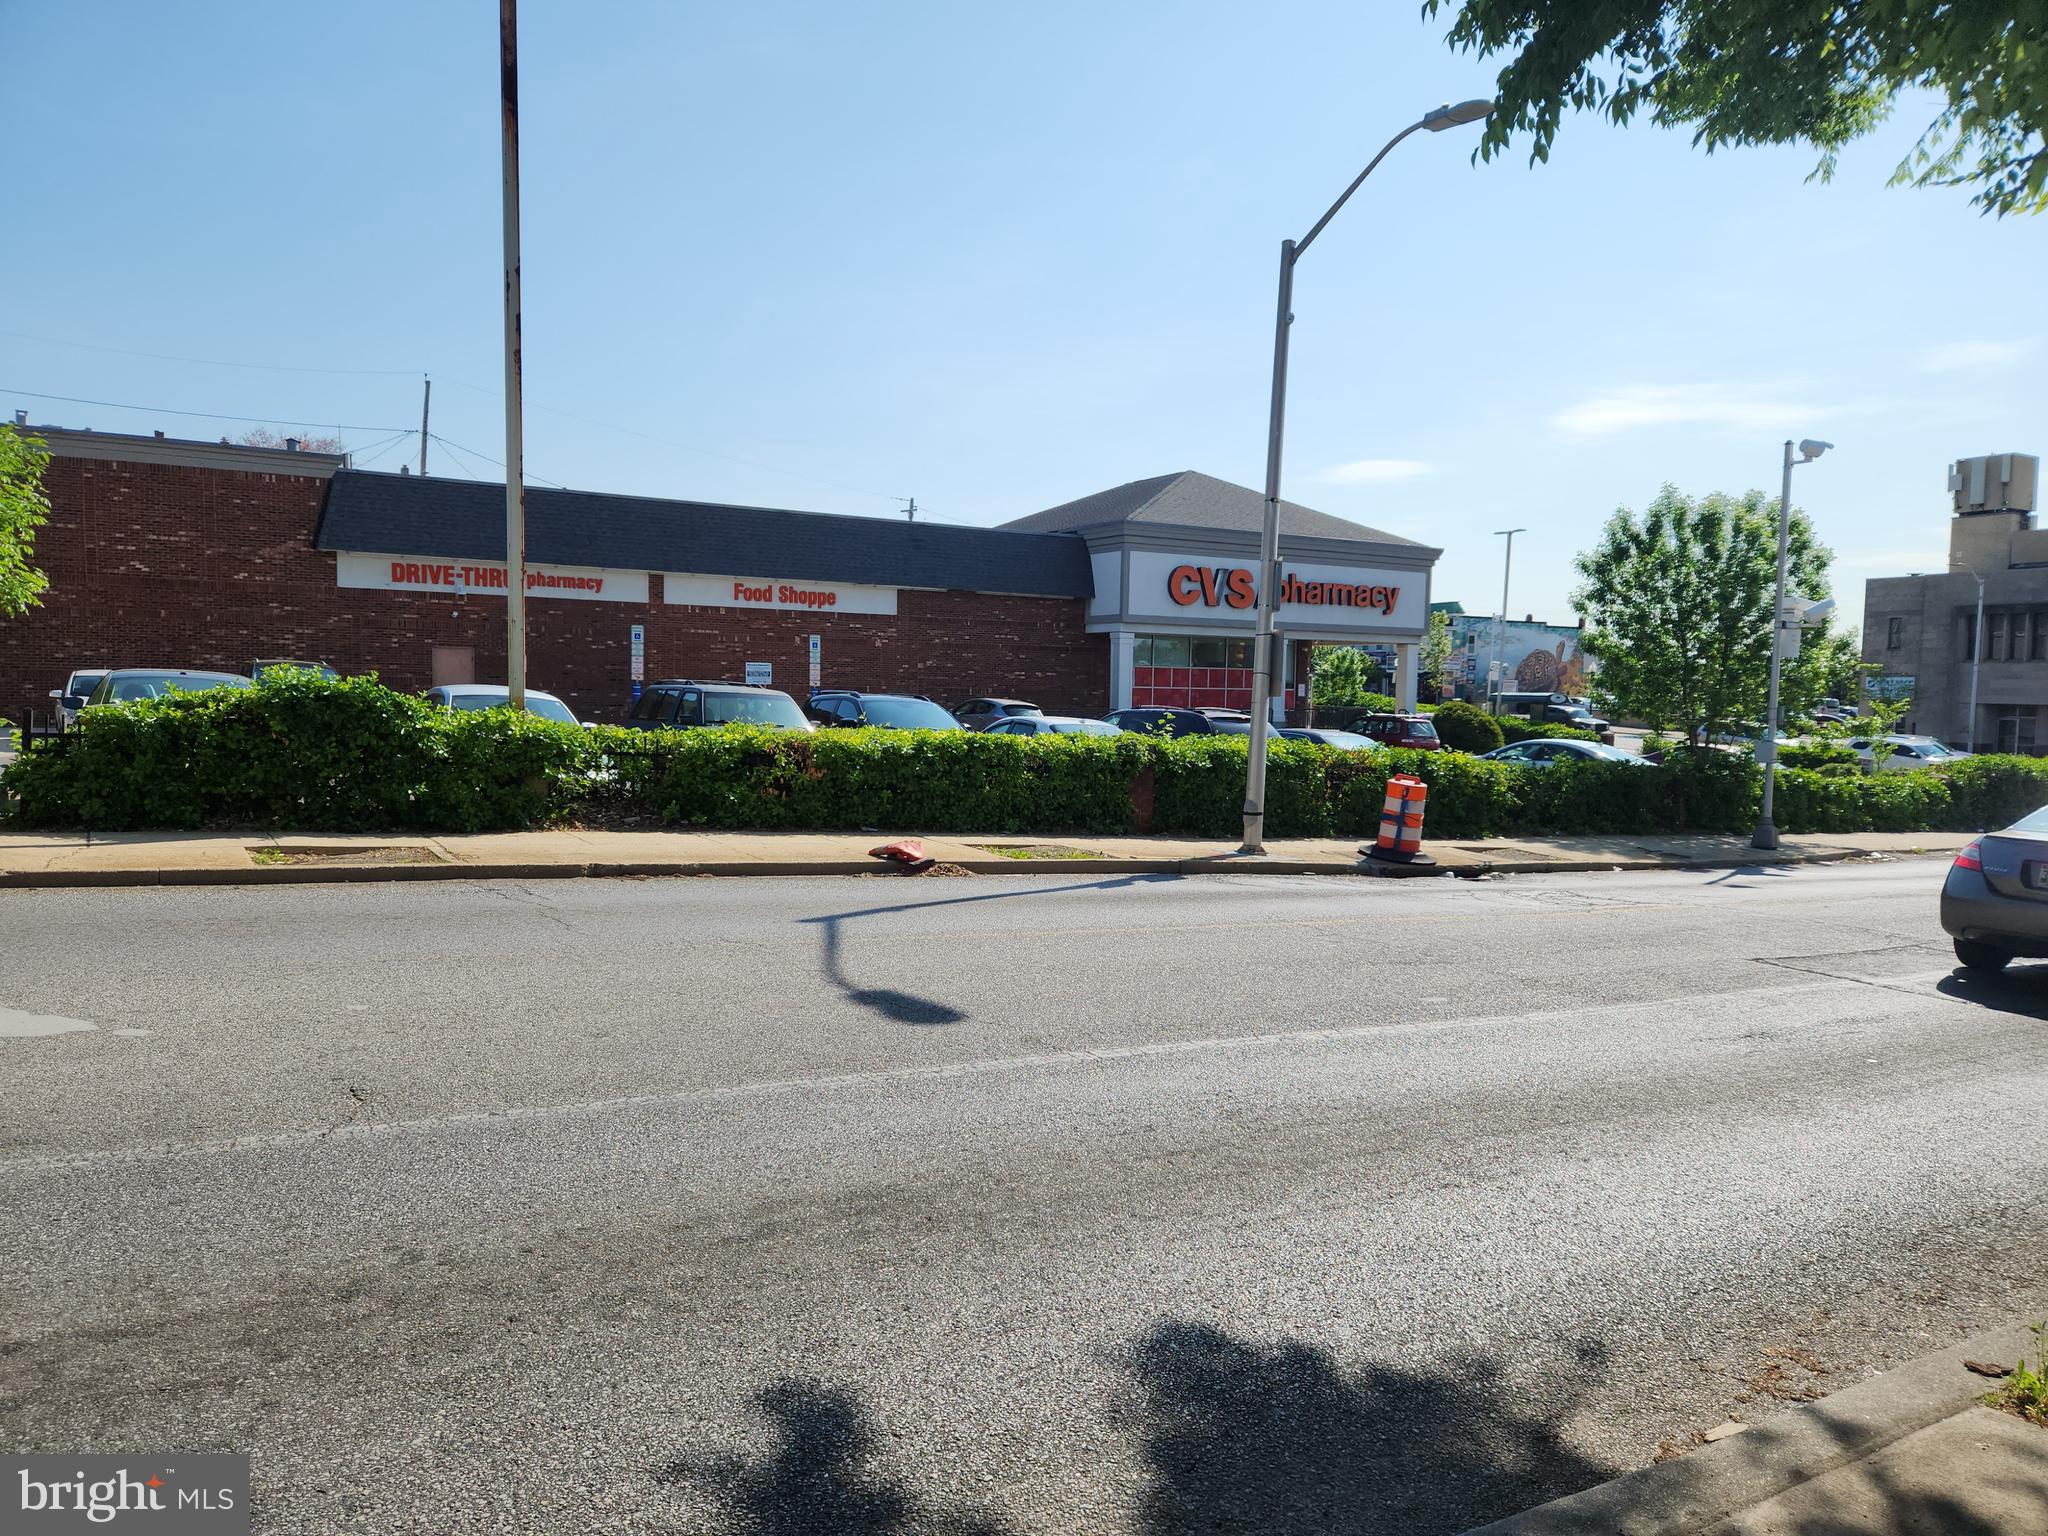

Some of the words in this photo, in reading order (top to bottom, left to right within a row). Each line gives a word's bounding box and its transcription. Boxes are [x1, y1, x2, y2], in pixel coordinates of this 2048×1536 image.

[527, 571, 604, 593] pharmacy
[733, 582, 773, 603] Food
[778, 585, 837, 609] Shoppe
